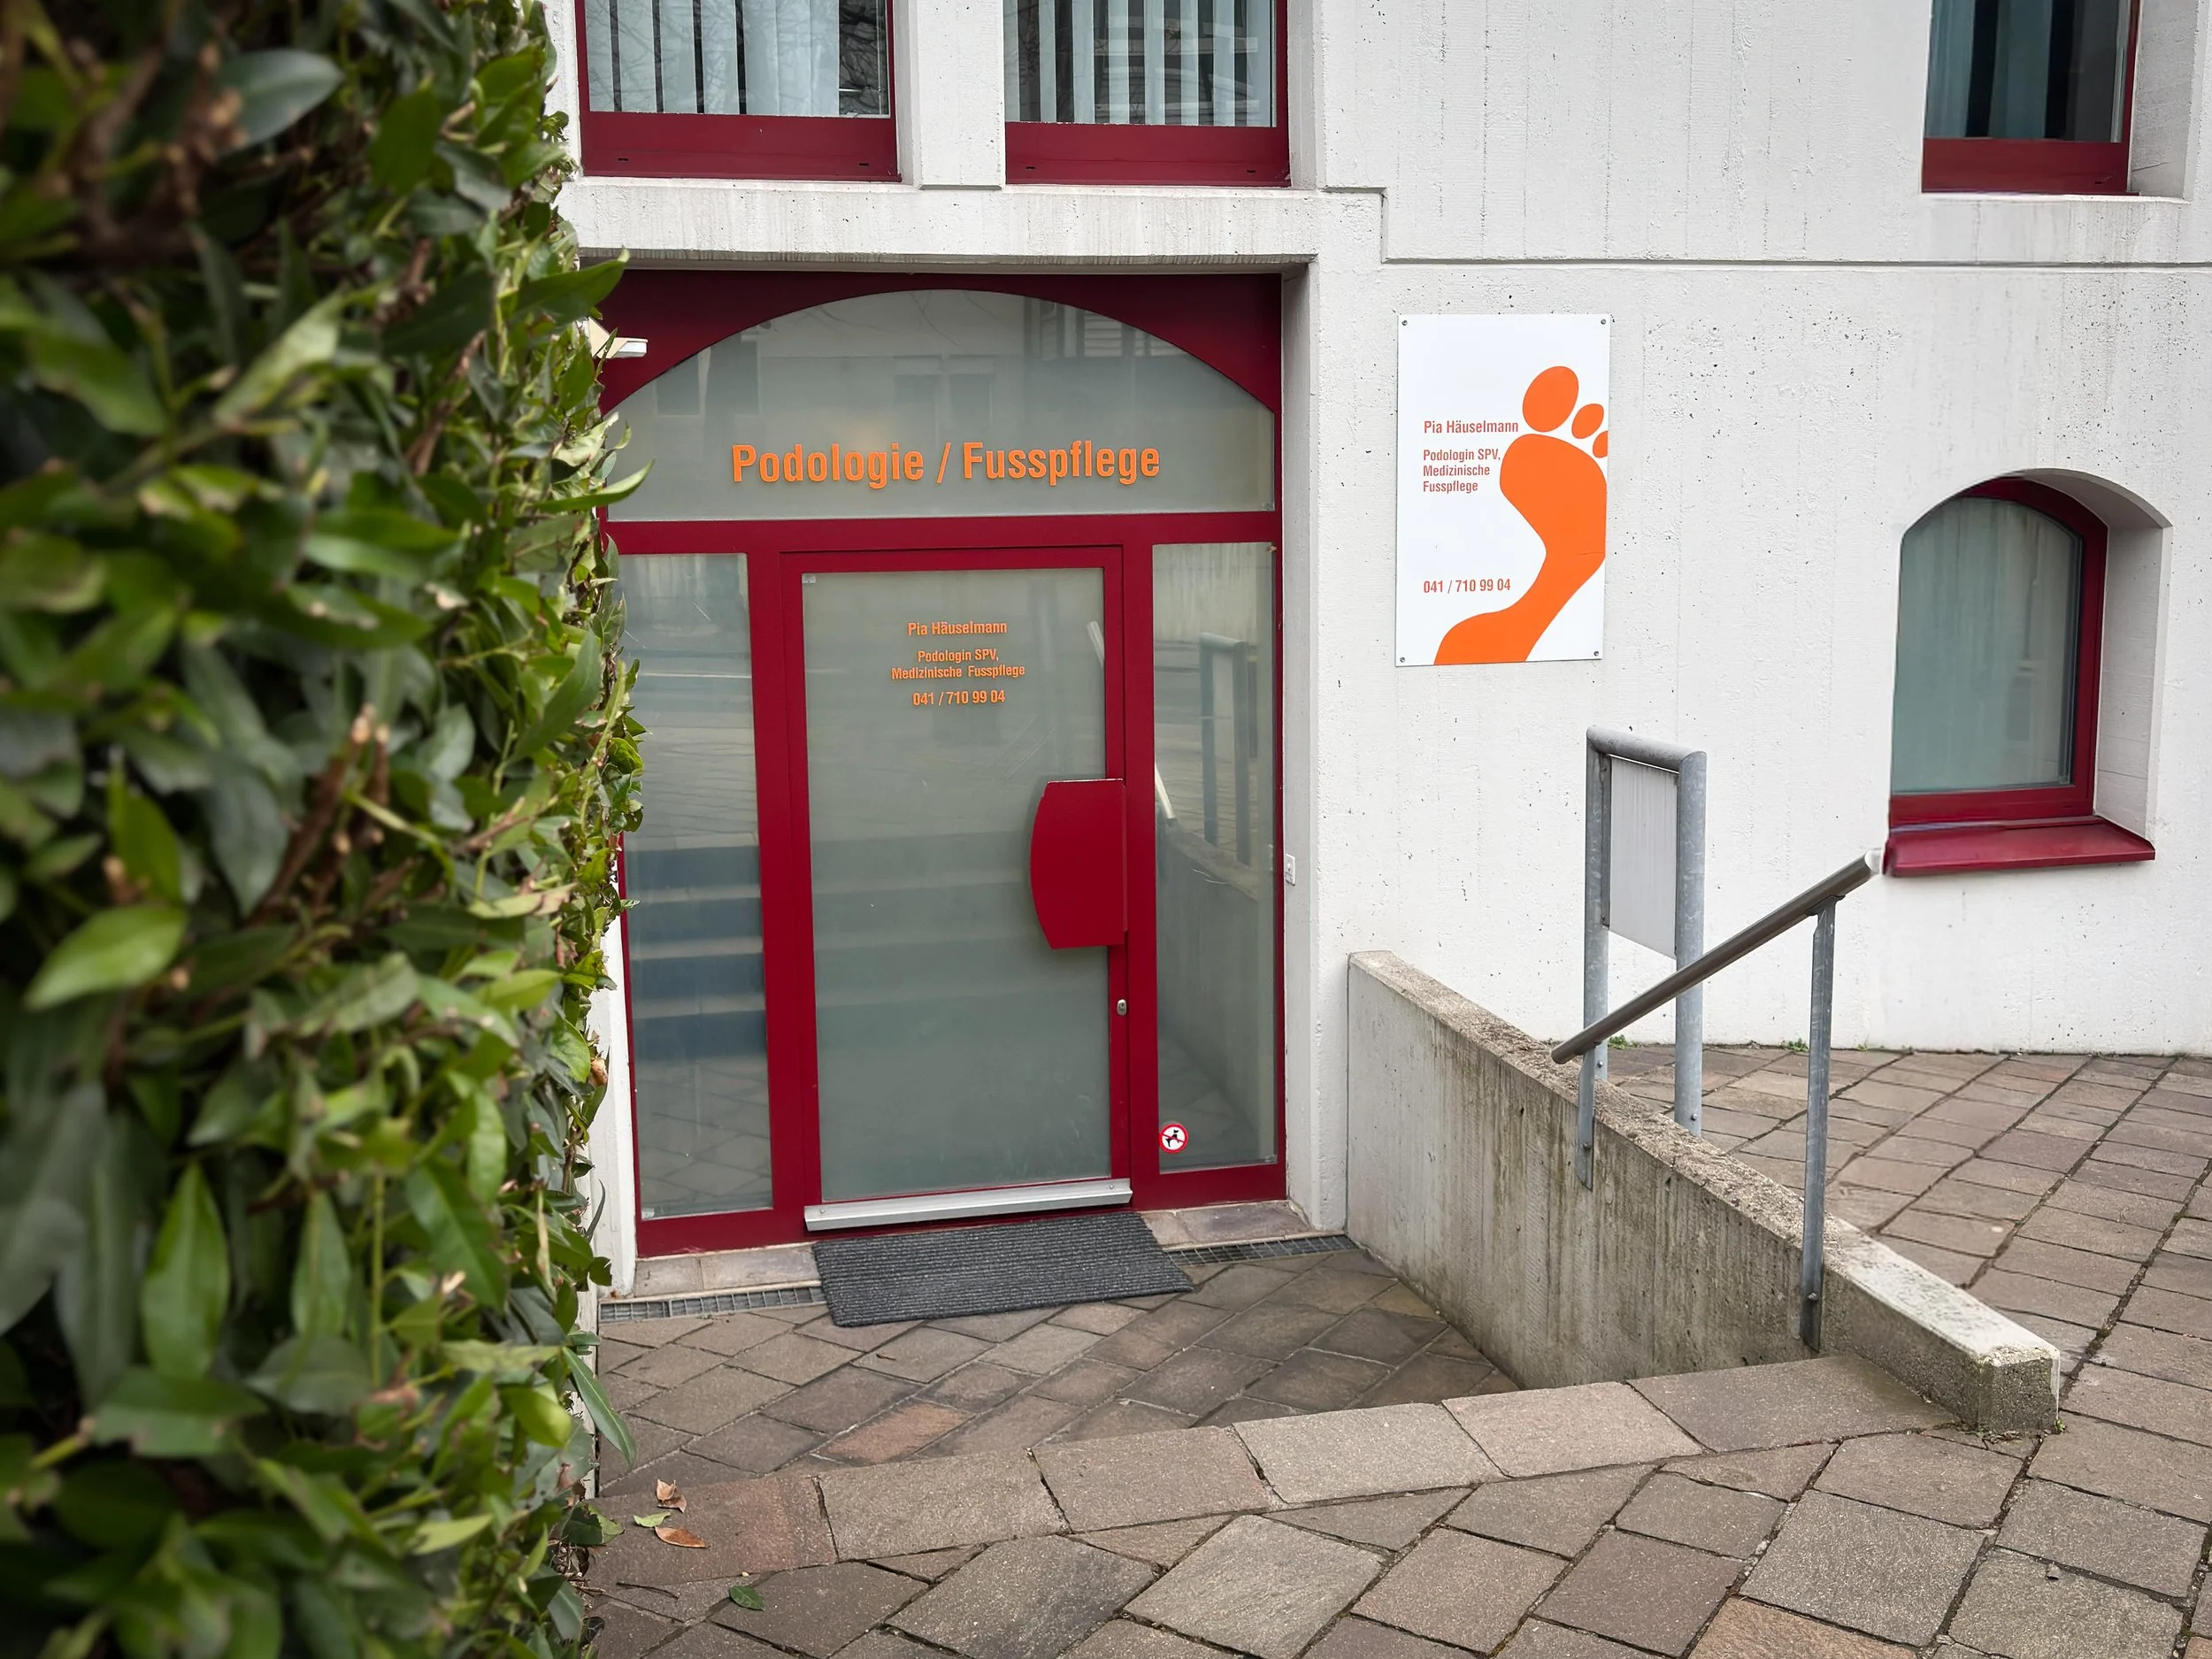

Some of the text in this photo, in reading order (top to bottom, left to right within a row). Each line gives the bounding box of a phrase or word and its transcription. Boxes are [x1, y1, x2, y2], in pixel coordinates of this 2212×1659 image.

[1424, 419, 1518, 434] Pia Häuselmann
[1423, 448, 1501, 463] Podologin SPV,
[732, 441, 1160, 489] Podologie / Fusspflege
[1423, 464, 1490, 477] Medizinische
[1423, 480, 1479, 495] Fusspflege
[1423, 580, 1444, 593] 041
[1455, 580, 1477, 593] 710
[1479, 579, 1494, 591] 99
[1496, 578, 1511, 591] 04
[907, 620, 1008, 636] Pia Häuselmann
[917, 649, 1000, 664] Podologin SPV,
[890, 664, 1025, 680] Medizinische Fusspflege
[912, 692, 934, 706] 041
[946, 691, 969, 705] 710
[973, 690, 987, 703] 99
[990, 689, 1006, 703] 04
